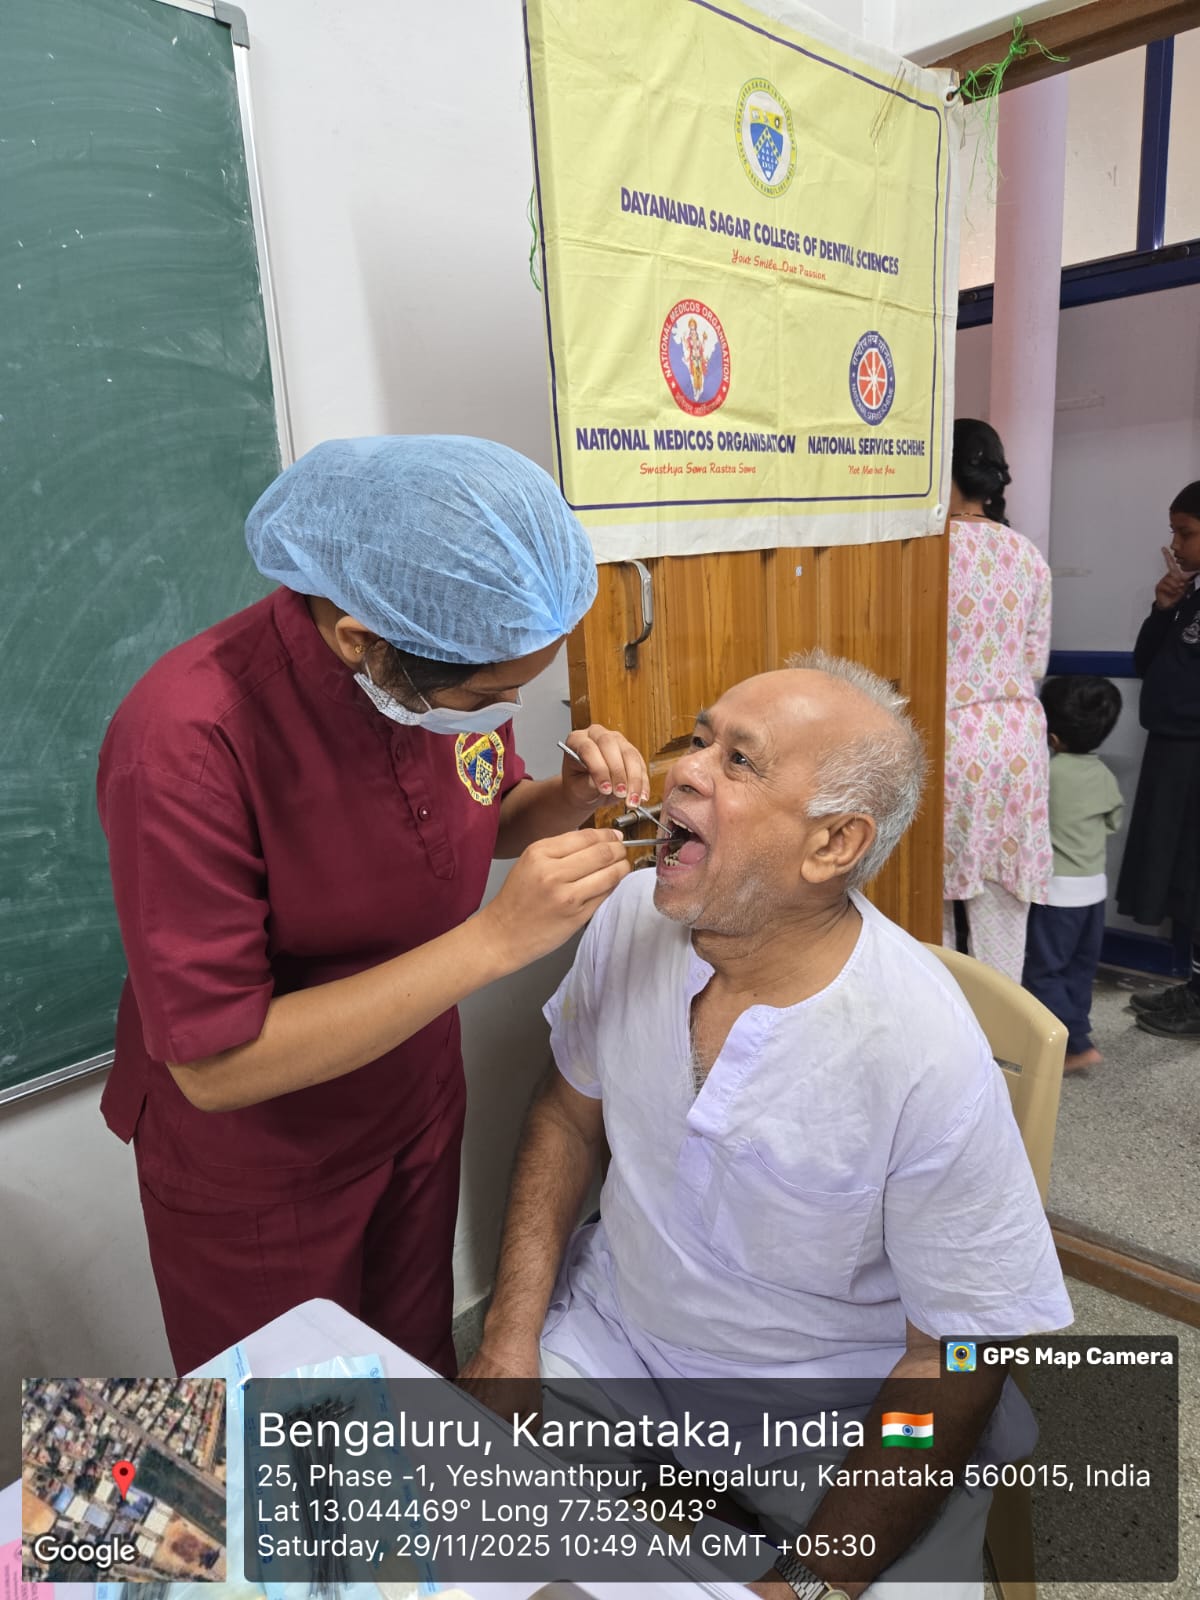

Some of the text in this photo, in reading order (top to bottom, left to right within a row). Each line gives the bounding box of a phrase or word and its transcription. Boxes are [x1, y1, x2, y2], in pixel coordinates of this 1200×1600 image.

[621, 187, 899, 275] DAYANANDA SAGAR COLLEGE OF DENTAL SCIENCES
[661, 301, 730, 383] NATIONAL MEDICOS ORGANISATION
[576, 428, 796, 453] NATIONAL MEDICOS ORGANISATION
[808, 436, 925, 456] NATIONAL SERVICE SCHEME
[639, 462, 683, 476] Swasthya
